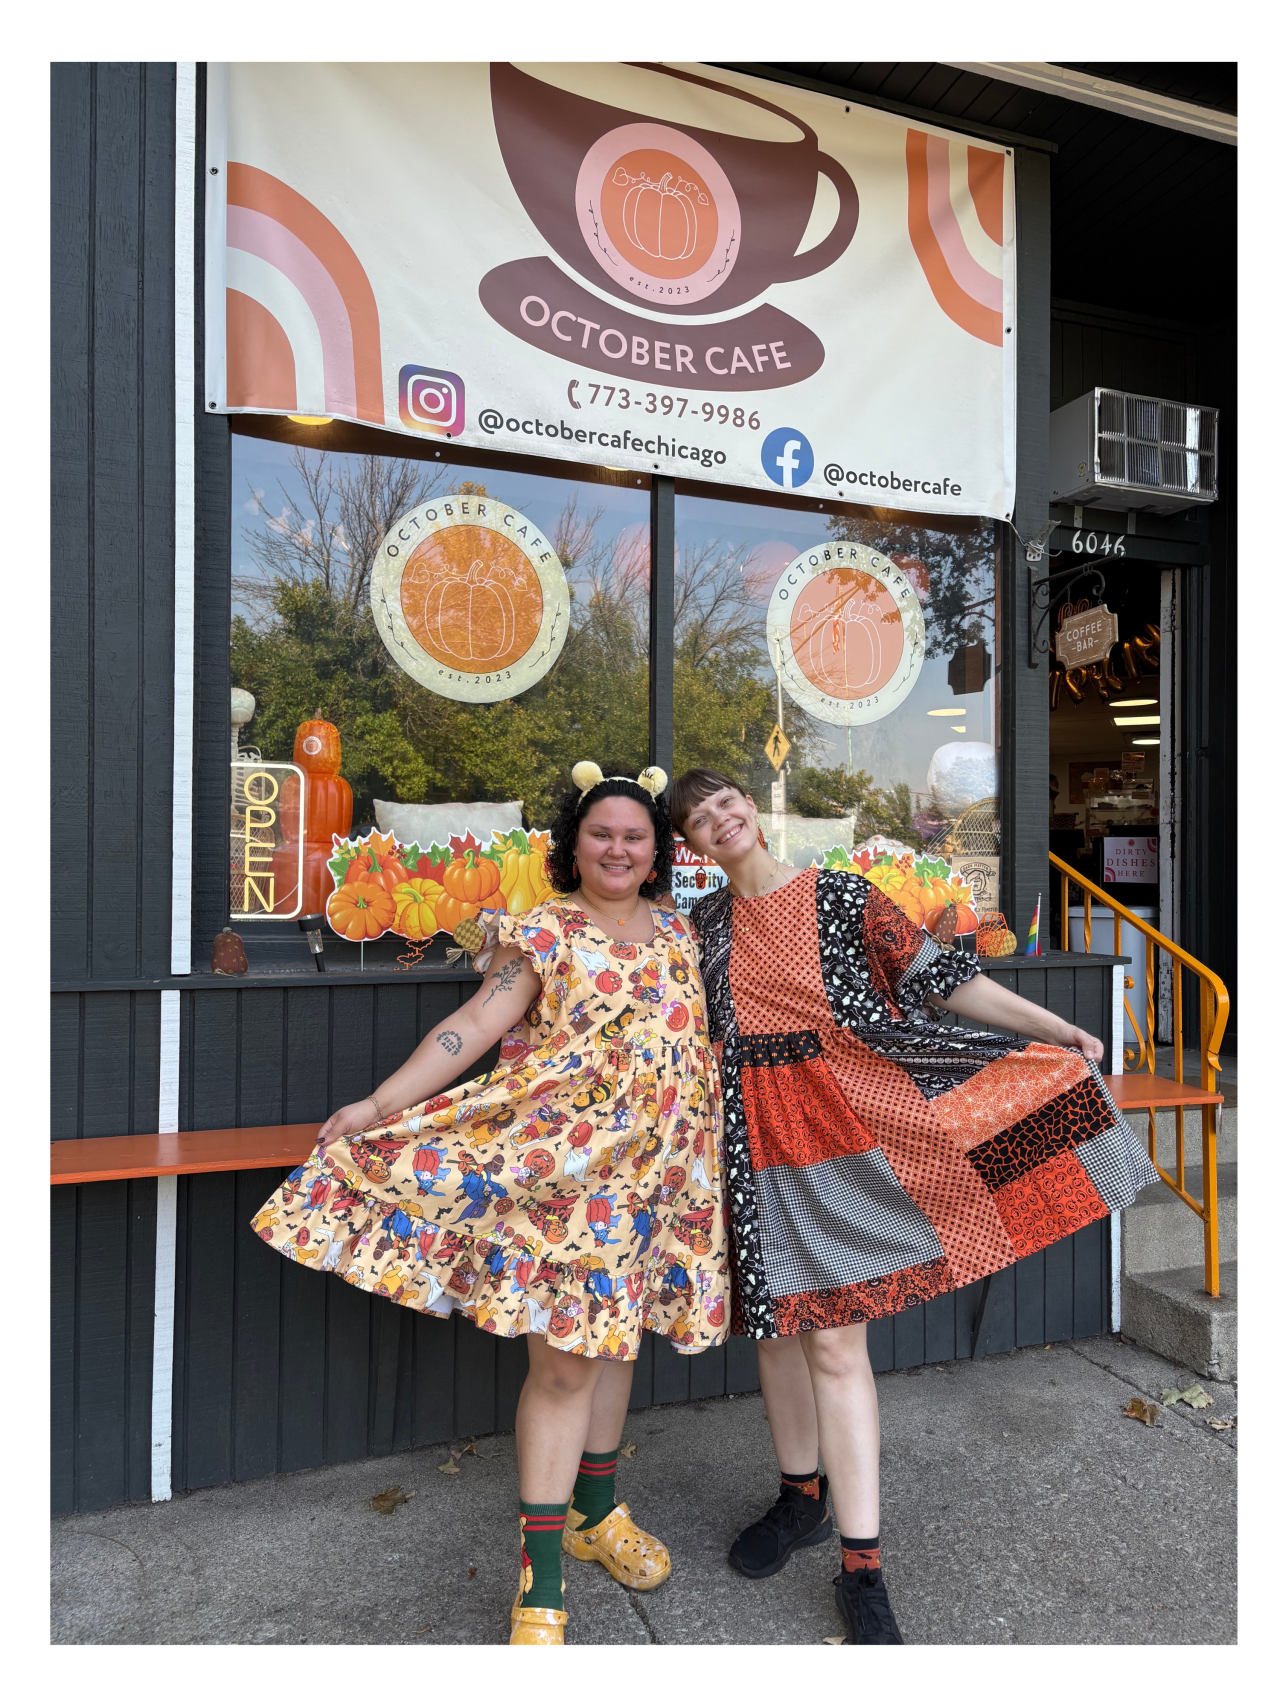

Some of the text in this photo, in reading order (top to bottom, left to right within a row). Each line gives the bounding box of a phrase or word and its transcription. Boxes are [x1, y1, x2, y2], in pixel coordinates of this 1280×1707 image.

[519, 295, 792, 375] OCTOBER CAFE
[588, 382, 761, 431] 773-397-9986
[478, 408, 727, 468] @octobercafechicago
[823, 463, 962, 496] @octobercafe
[386, 502, 551, 563] OCTOBER CAFE
[1072, 529, 1126, 557] 6046
[778, 547, 911, 601] OCTOBER CAFE
[1066, 620, 1102, 642] COFFEE
[244, 772, 279, 913] OPEN
[1106, 858, 1156, 867] DISHES
[1115, 848, 1148, 856] DIRTY
[675, 871, 723, 889] Secity
